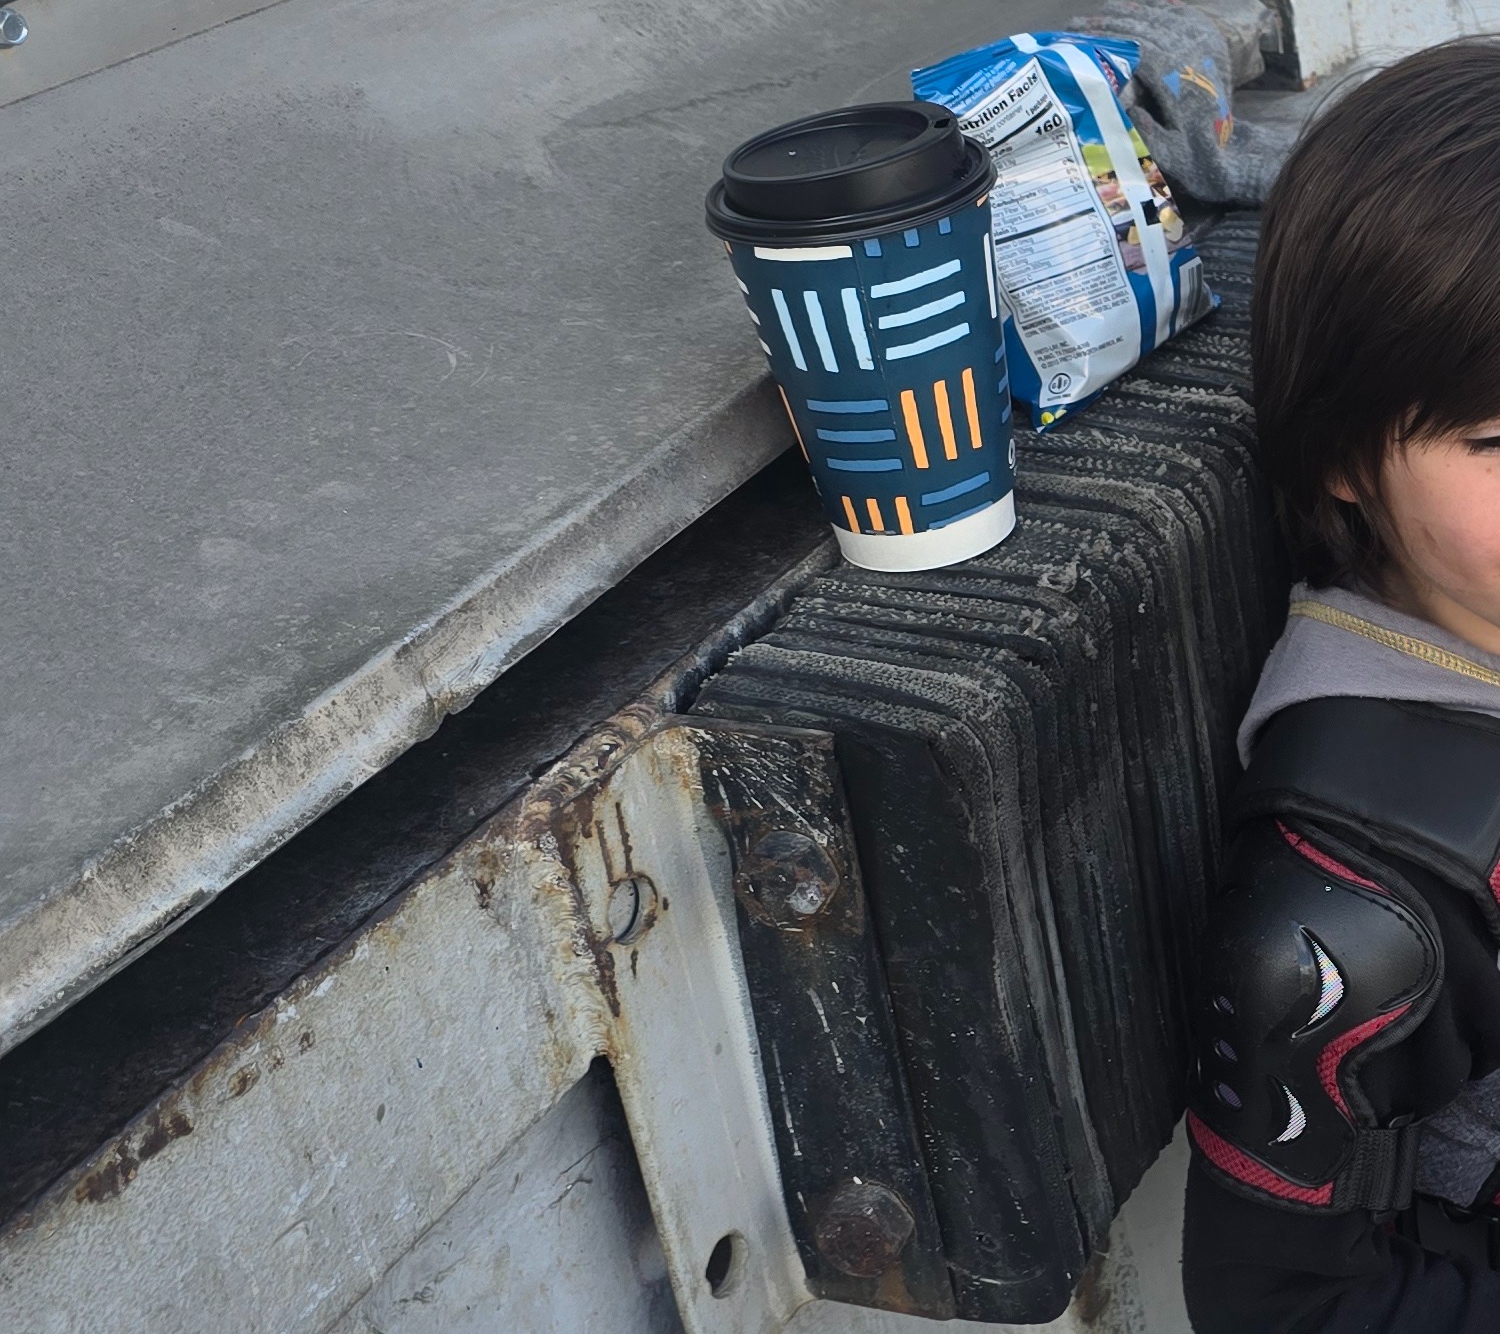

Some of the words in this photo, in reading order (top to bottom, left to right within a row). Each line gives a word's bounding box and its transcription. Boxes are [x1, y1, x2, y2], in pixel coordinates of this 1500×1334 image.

[960, 99, 1008, 131] utrition
[1007, 73, 1038, 103] Facts
[1035, 113, 1063, 136] 160
